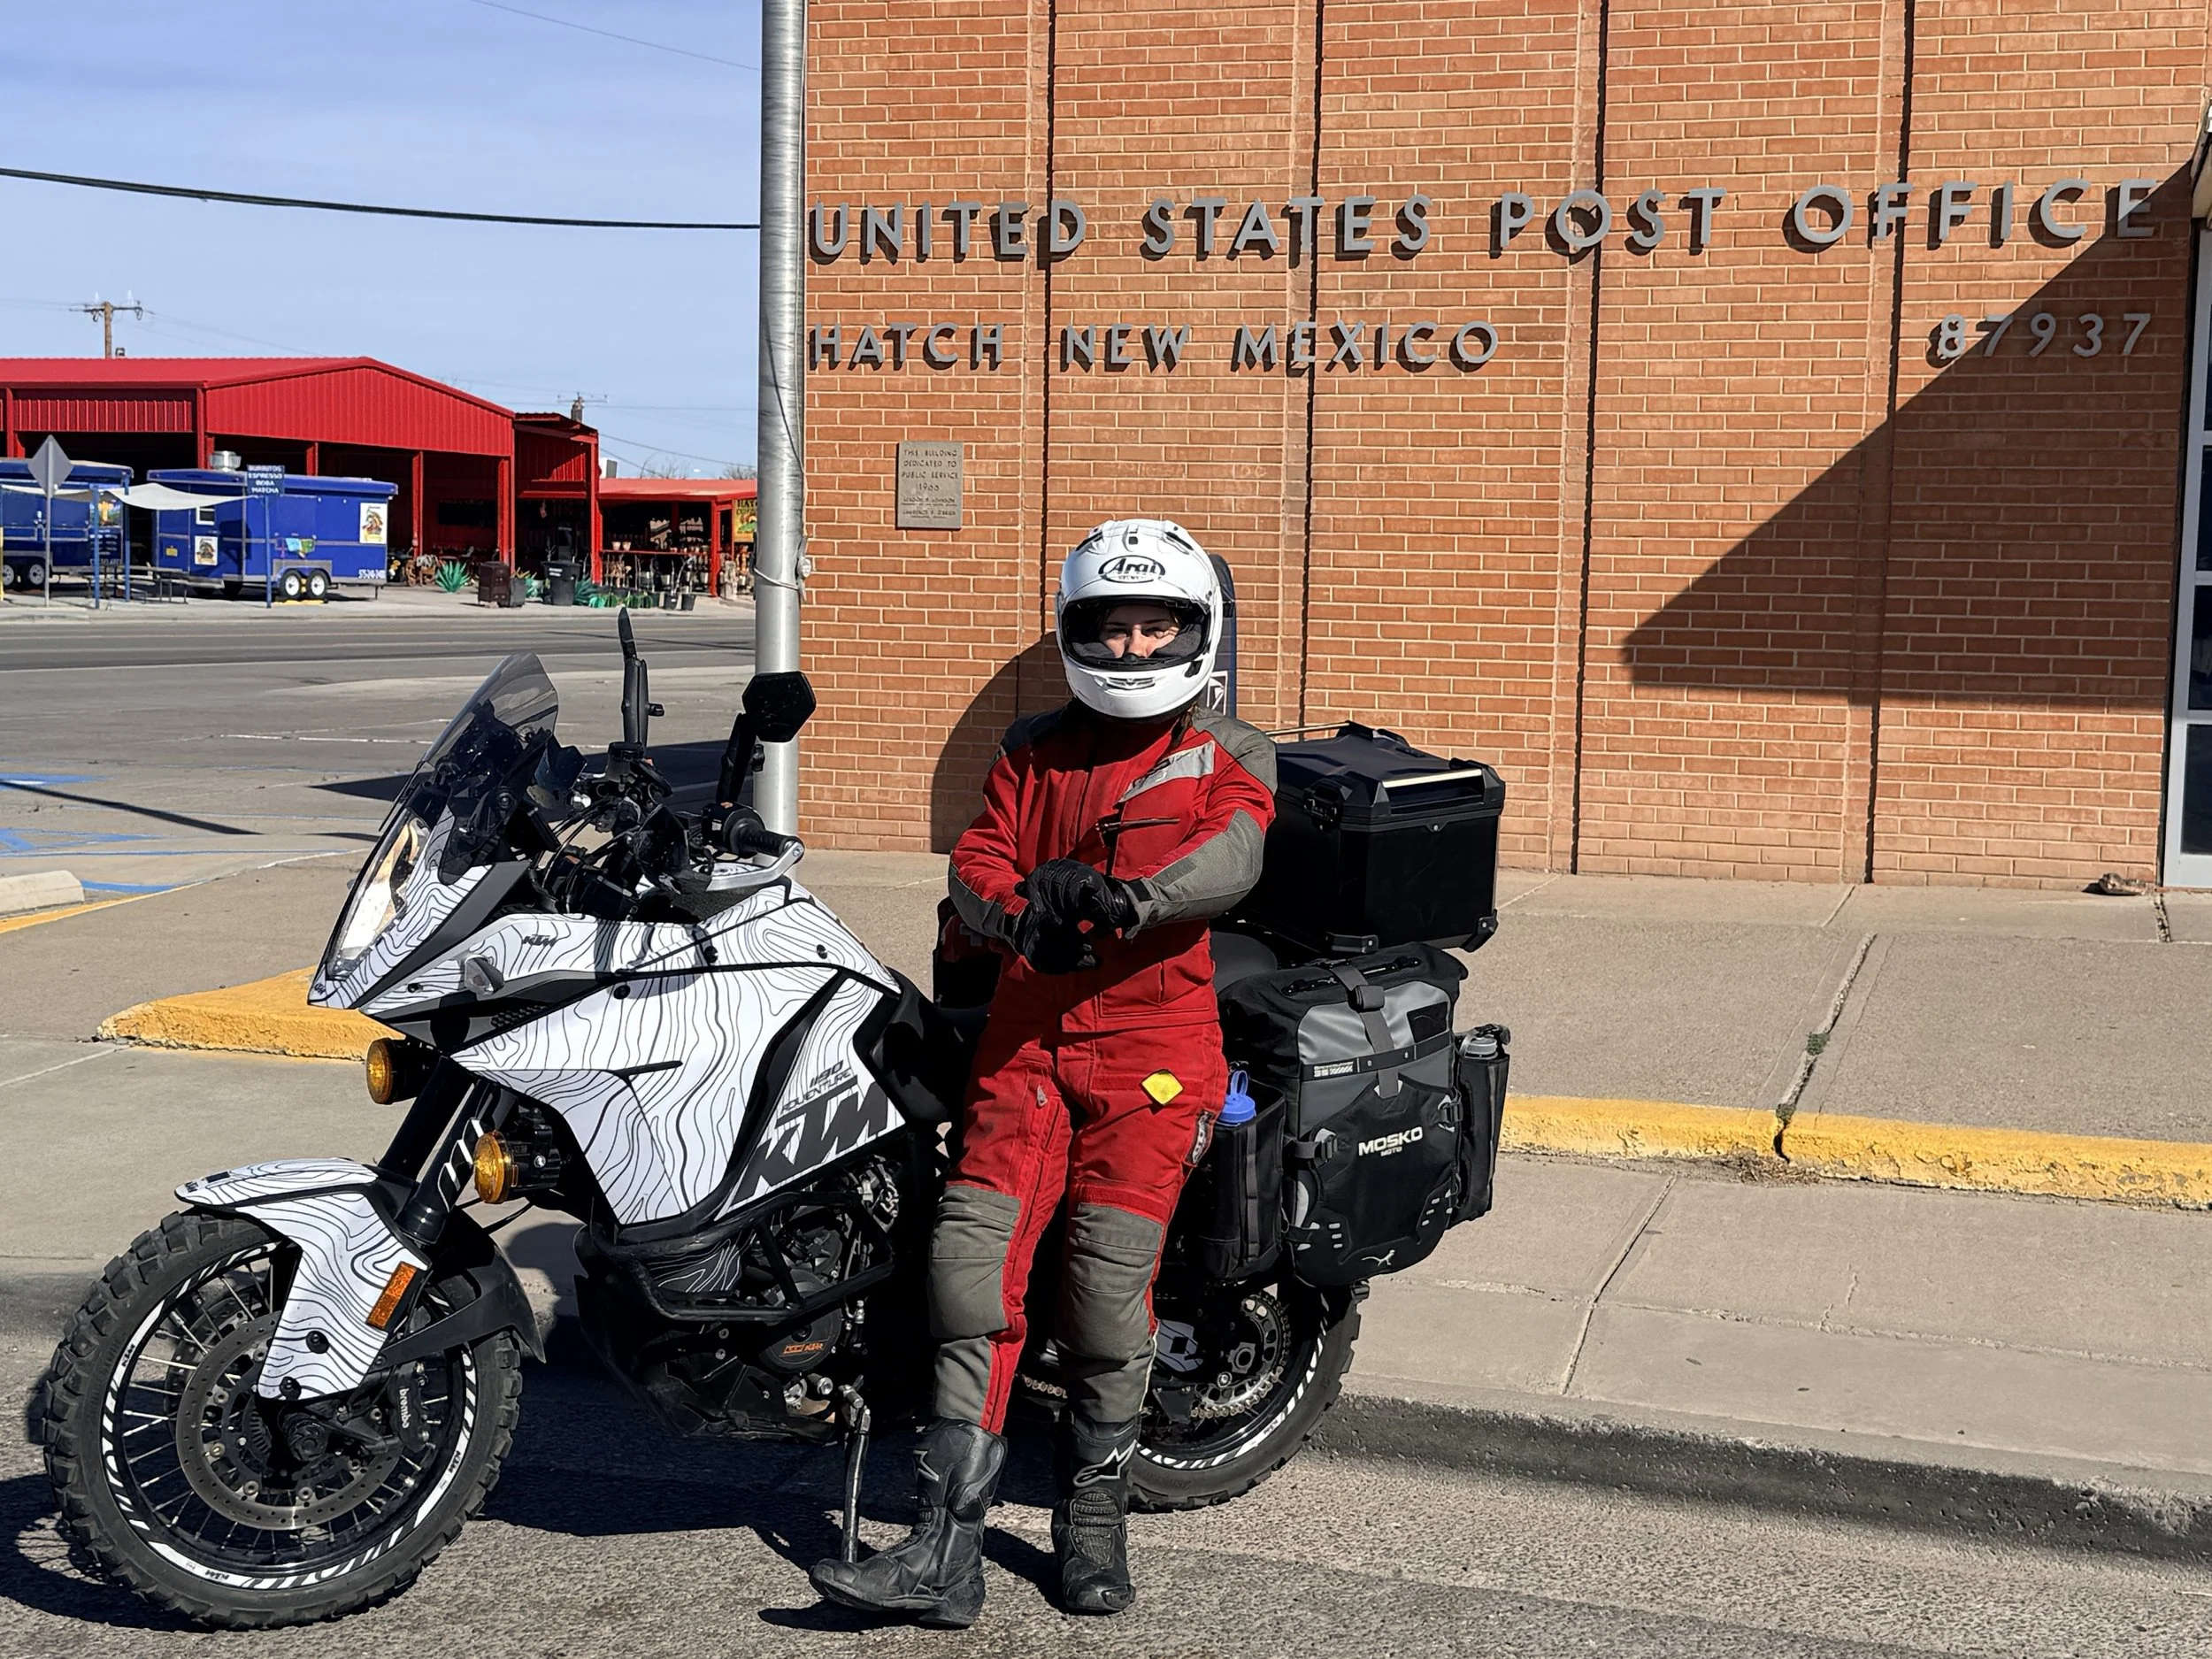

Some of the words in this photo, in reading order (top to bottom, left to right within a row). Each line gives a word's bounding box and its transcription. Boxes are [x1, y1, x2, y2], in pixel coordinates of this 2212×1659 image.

[814, 199, 1087, 256] UNITED
[1144, 194, 1434, 254] STATES
[1500, 187, 1727, 248] POST
[1793, 179, 2157, 244] OFFICE
[814, 321, 1004, 364] HATCH
[1066, 322, 1191, 365] NEW
[1237, 319, 1499, 365] MEXICO
[1938, 312, 2152, 358] 87937
[1106, 557, 1157, 575] Arai
[780, 1069, 852, 1114] ADVENTURE
[810, 1059, 844, 1088] 1190
[733, 1074, 889, 1207] KTM
[1358, 1126, 1424, 1156] MOSKO
[1380, 1146, 1402, 1156] MOTO
[399, 1387, 411, 1429] brembo
